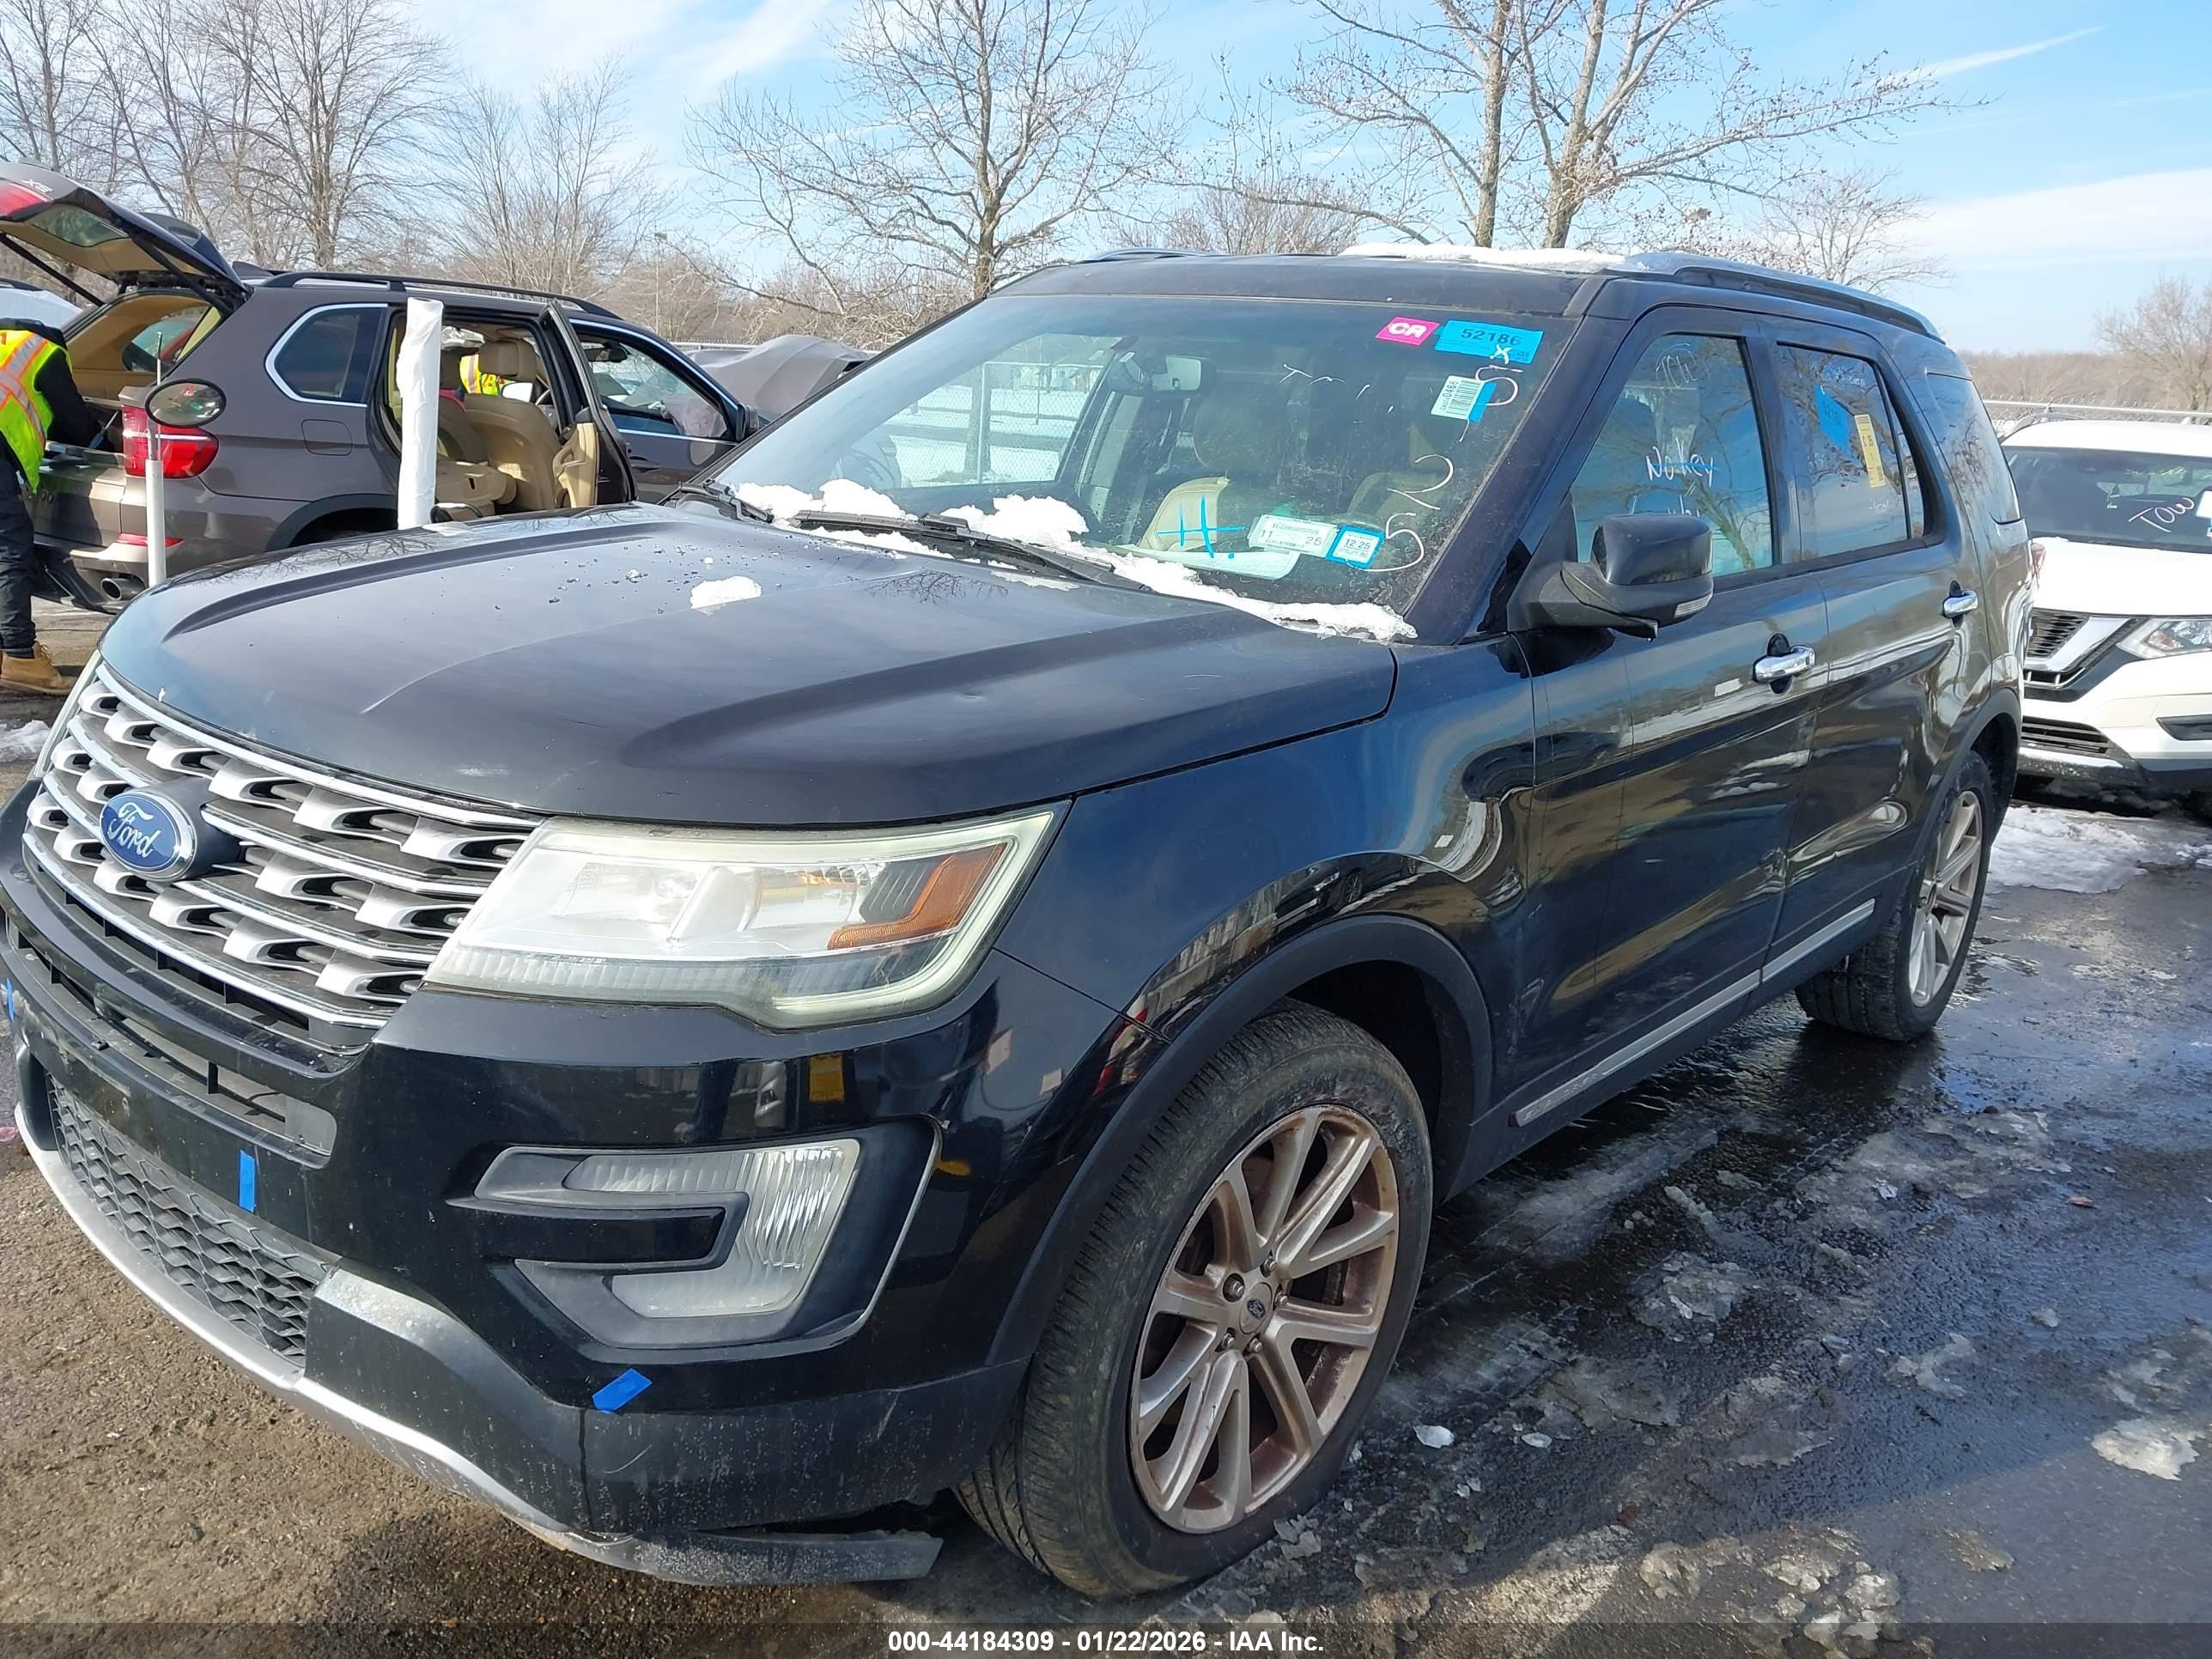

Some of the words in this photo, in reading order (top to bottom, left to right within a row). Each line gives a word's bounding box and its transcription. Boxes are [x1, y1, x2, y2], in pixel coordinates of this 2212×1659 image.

[1461, 328, 1522, 345] 52186
[1304, 536, 1323, 546] 25
[107, 802, 161, 858] Ford
